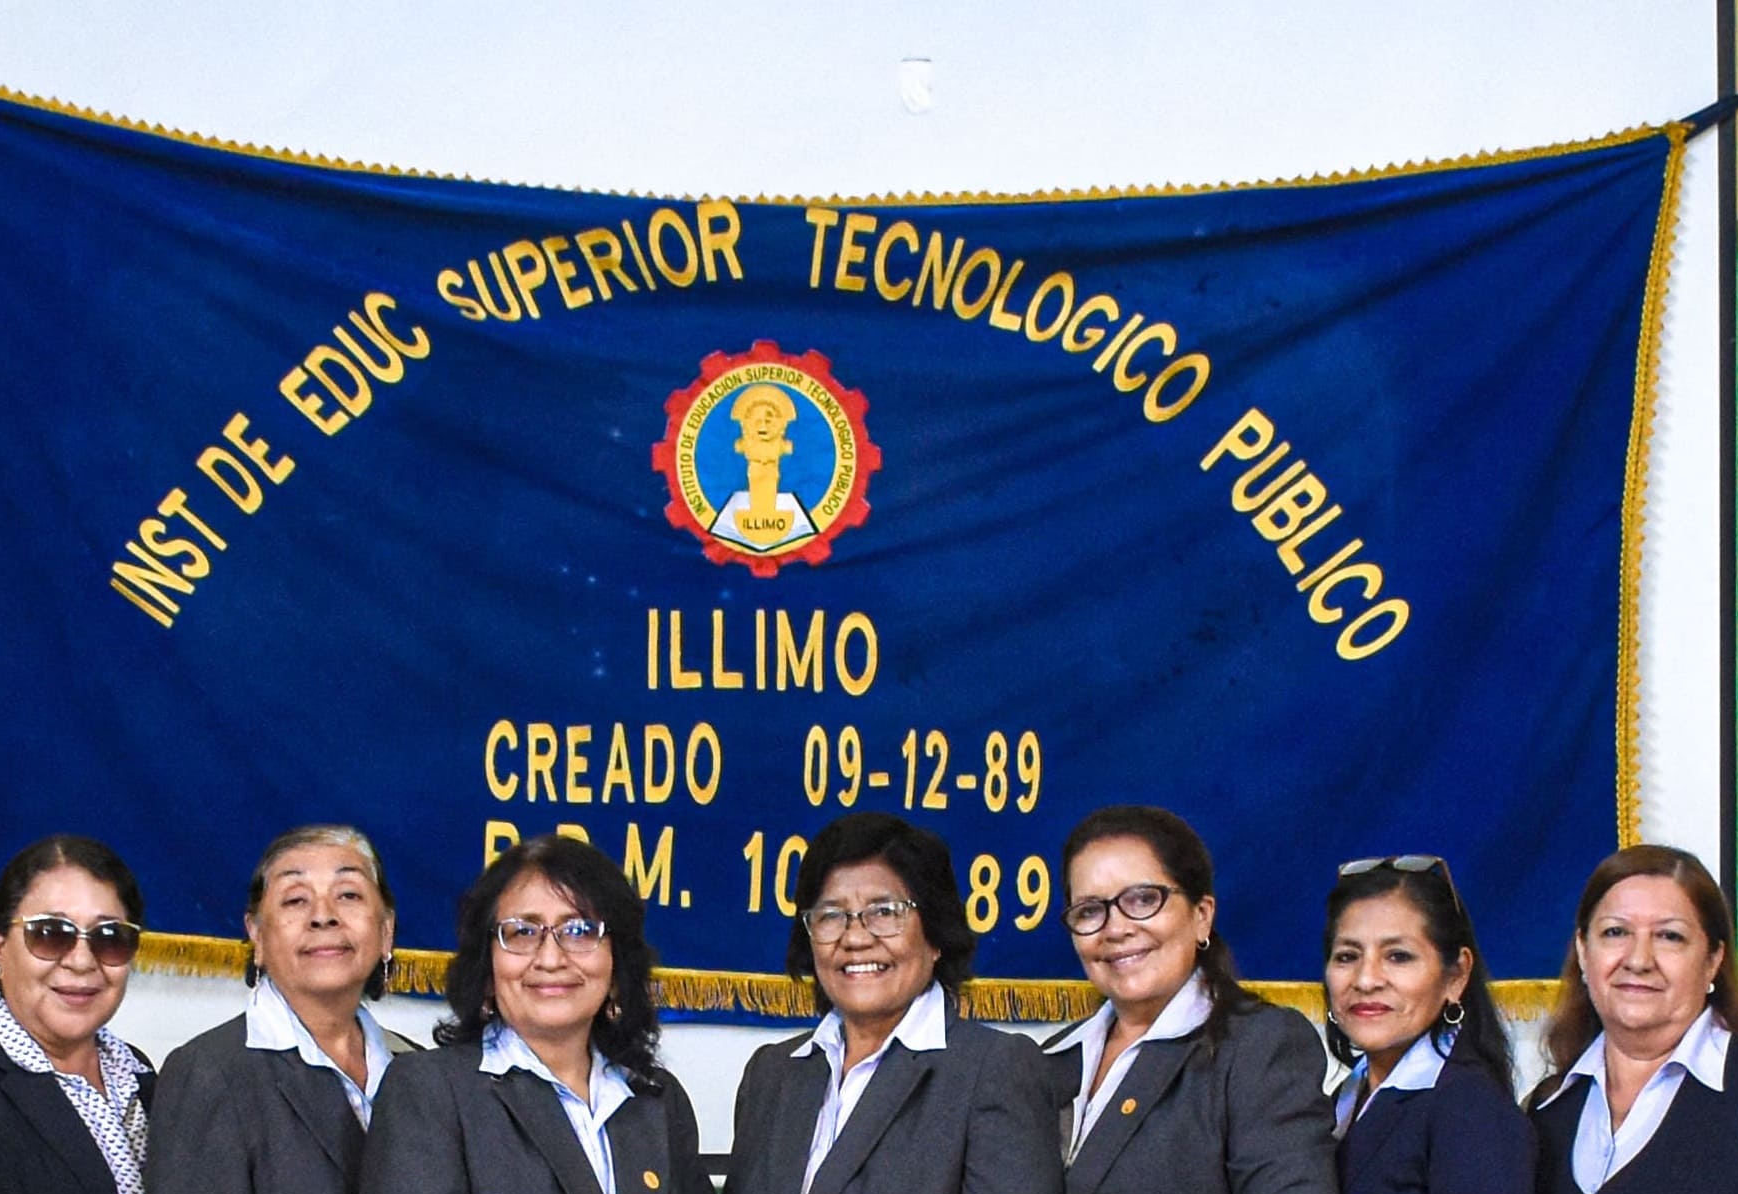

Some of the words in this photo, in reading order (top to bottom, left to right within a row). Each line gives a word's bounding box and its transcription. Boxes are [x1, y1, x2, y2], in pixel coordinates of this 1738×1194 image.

[687, 372, 743, 430] EDUCACION
[745, 366, 804, 388] SUPERIOR
[112, 487, 228, 628] INST
[196, 412, 296, 515] DE
[278, 292, 431, 436] EDUC
[437, 200, 743, 321] SUPERIOR
[805, 207, 1211, 423] TECNOLOGICO
[1201, 407, 1410, 661] PUBLICO
[680, 434, 696, 450] DE
[807, 381, 855, 460] TECNOLOGICO
[680, 454, 707, 517] INSTITUTO
[822, 464, 854, 517] PUBLICO
[742, 518, 786, 531] ILLIMO
[647, 608, 878, 696] ILLIMO
[485, 719, 722, 805] CREADO
[803, 725, 1042, 814] 09-12-89
